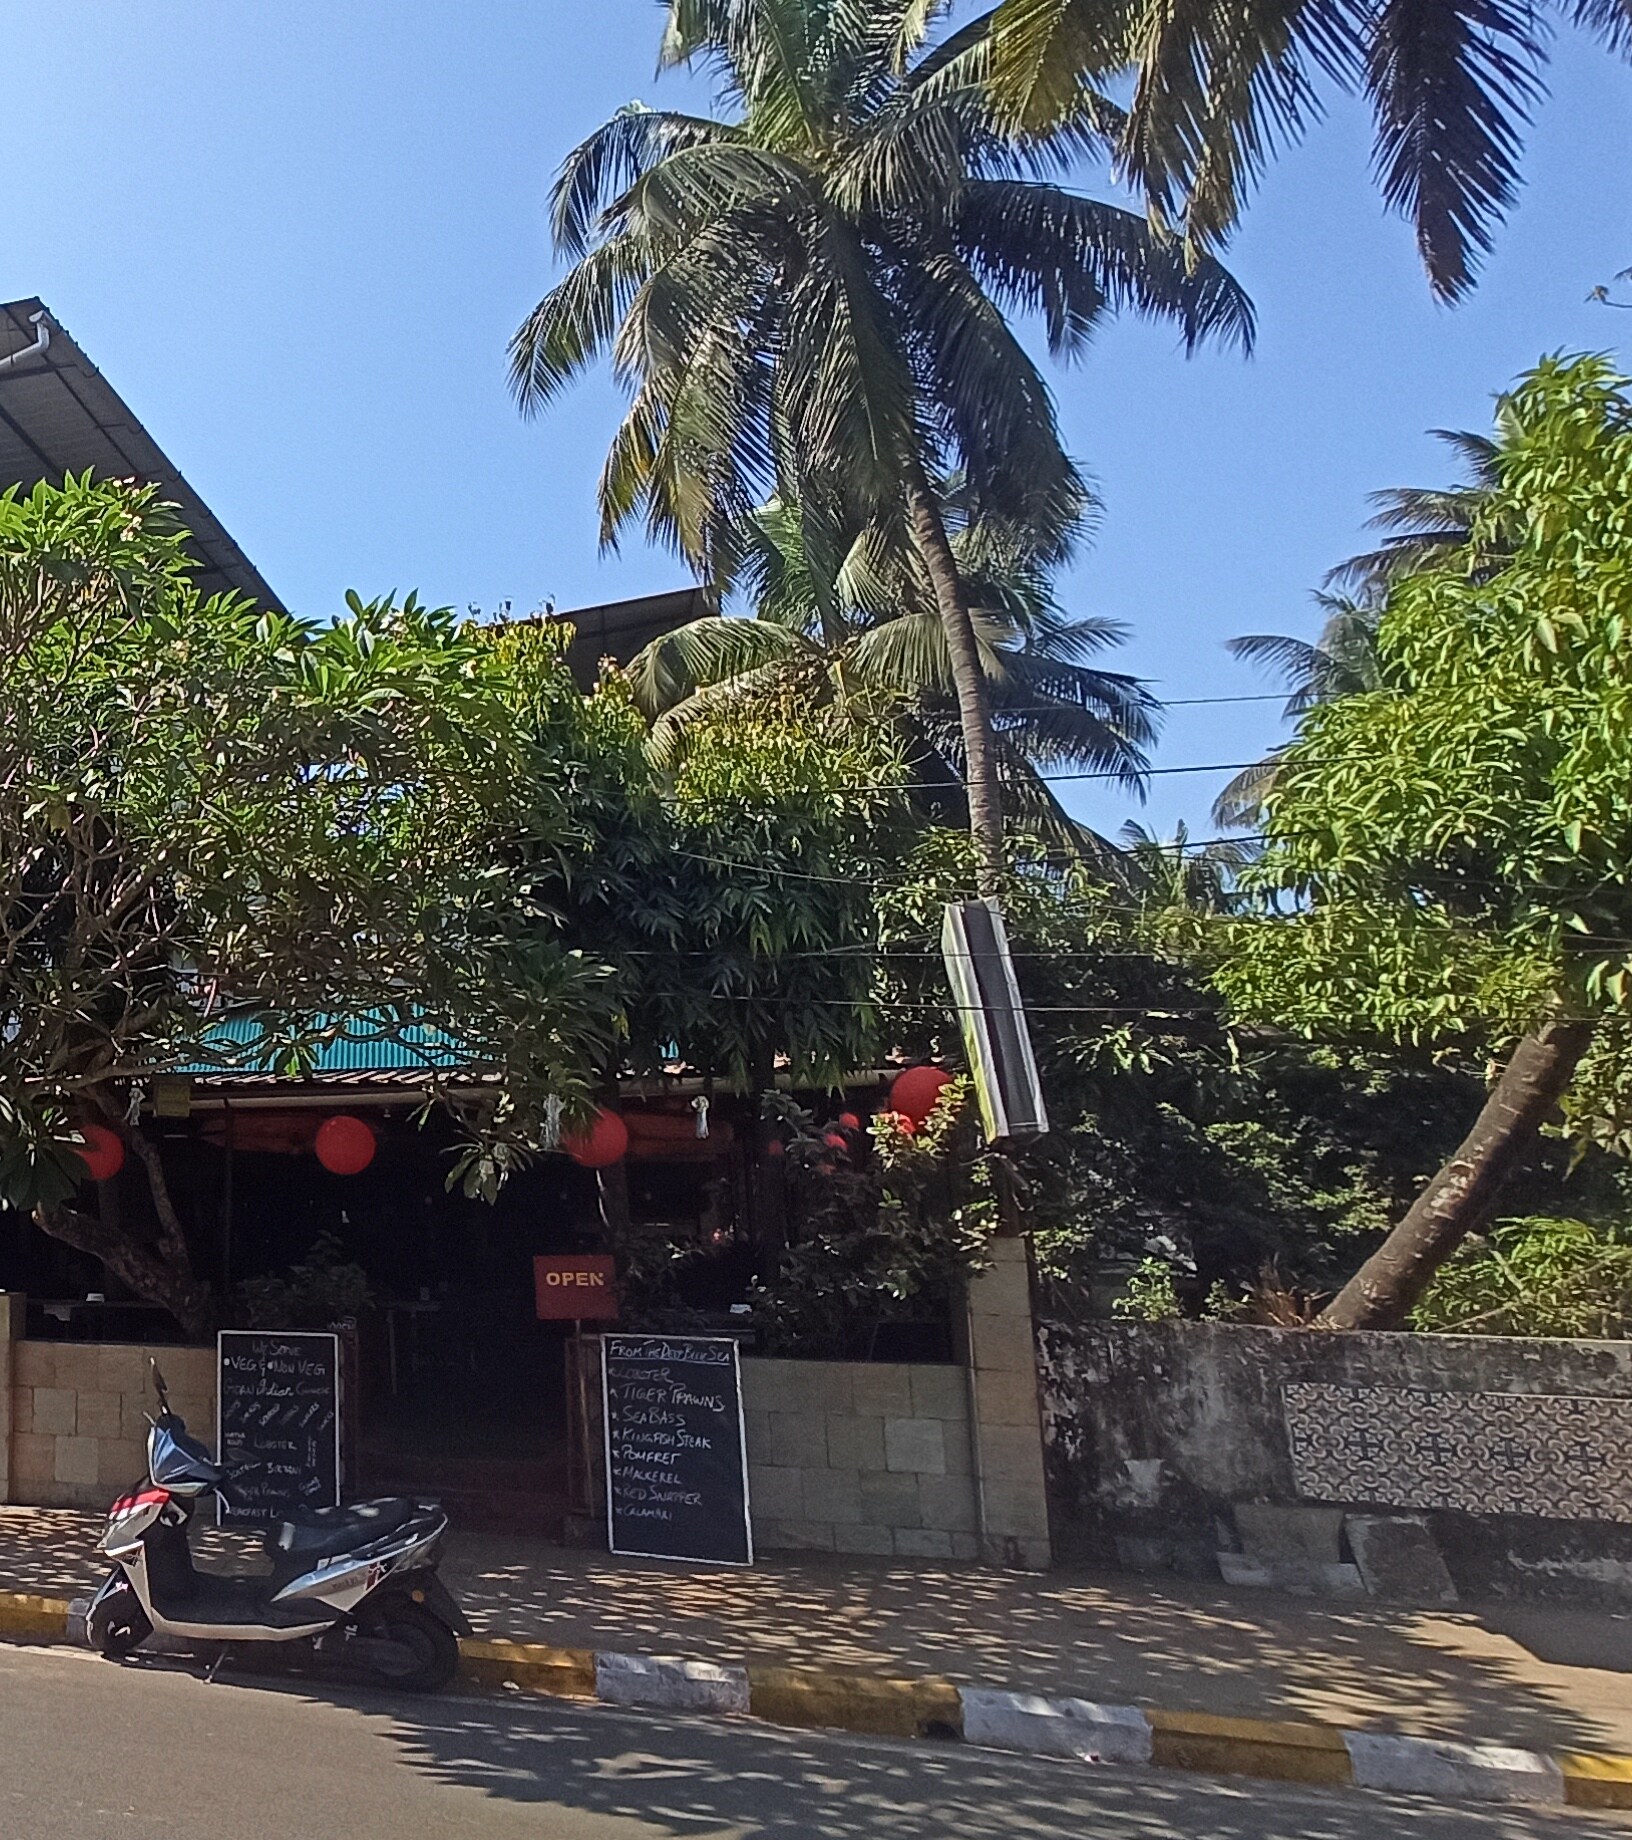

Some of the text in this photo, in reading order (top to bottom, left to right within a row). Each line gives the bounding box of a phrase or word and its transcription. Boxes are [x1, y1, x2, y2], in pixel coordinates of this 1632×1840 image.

[546, 1271, 604, 1287] OPEN
[610, 1339, 642, 1357] FROM
[297, 1360, 326, 1376] VEG
[619, 1382, 726, 1412] TIGER PRAWNS
[622, 1427, 712, 1449] KINGFISH STEAK
[621, 1443, 683, 1465] POMFRET
[622, 1465, 683, 1485] MACKEREL
